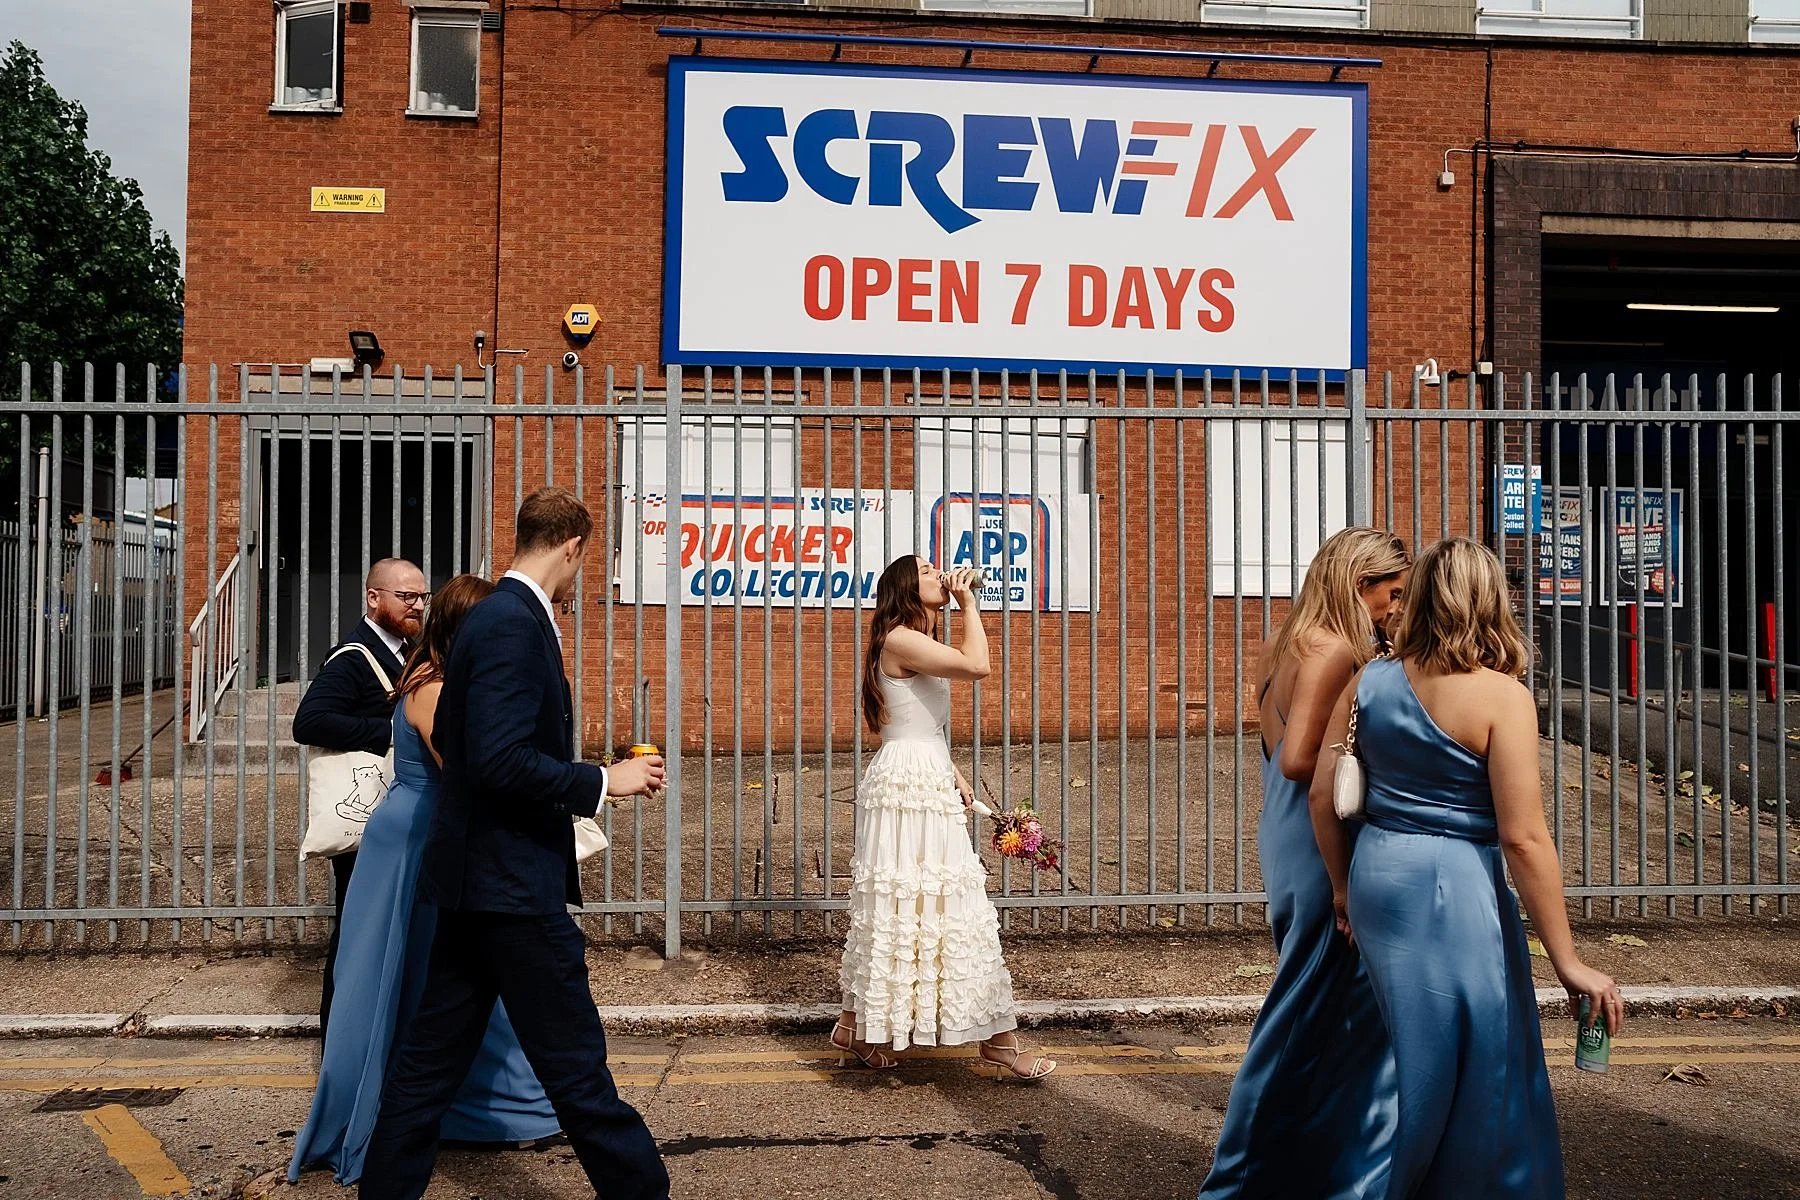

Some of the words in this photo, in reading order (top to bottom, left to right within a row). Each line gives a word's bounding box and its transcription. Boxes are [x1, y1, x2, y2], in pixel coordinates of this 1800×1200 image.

[720, 105, 1317, 234] SCREWFIX
[333, 194, 364, 202] WARNING
[803, 254, 980, 324] OPEN
[1004, 264, 1042, 326] 7
[1068, 265, 1236, 333] DAYS
[572, 313, 590, 324] ADT
[953, 530, 1028, 566] APP
[1581, 1026, 1603, 1039] GIN
